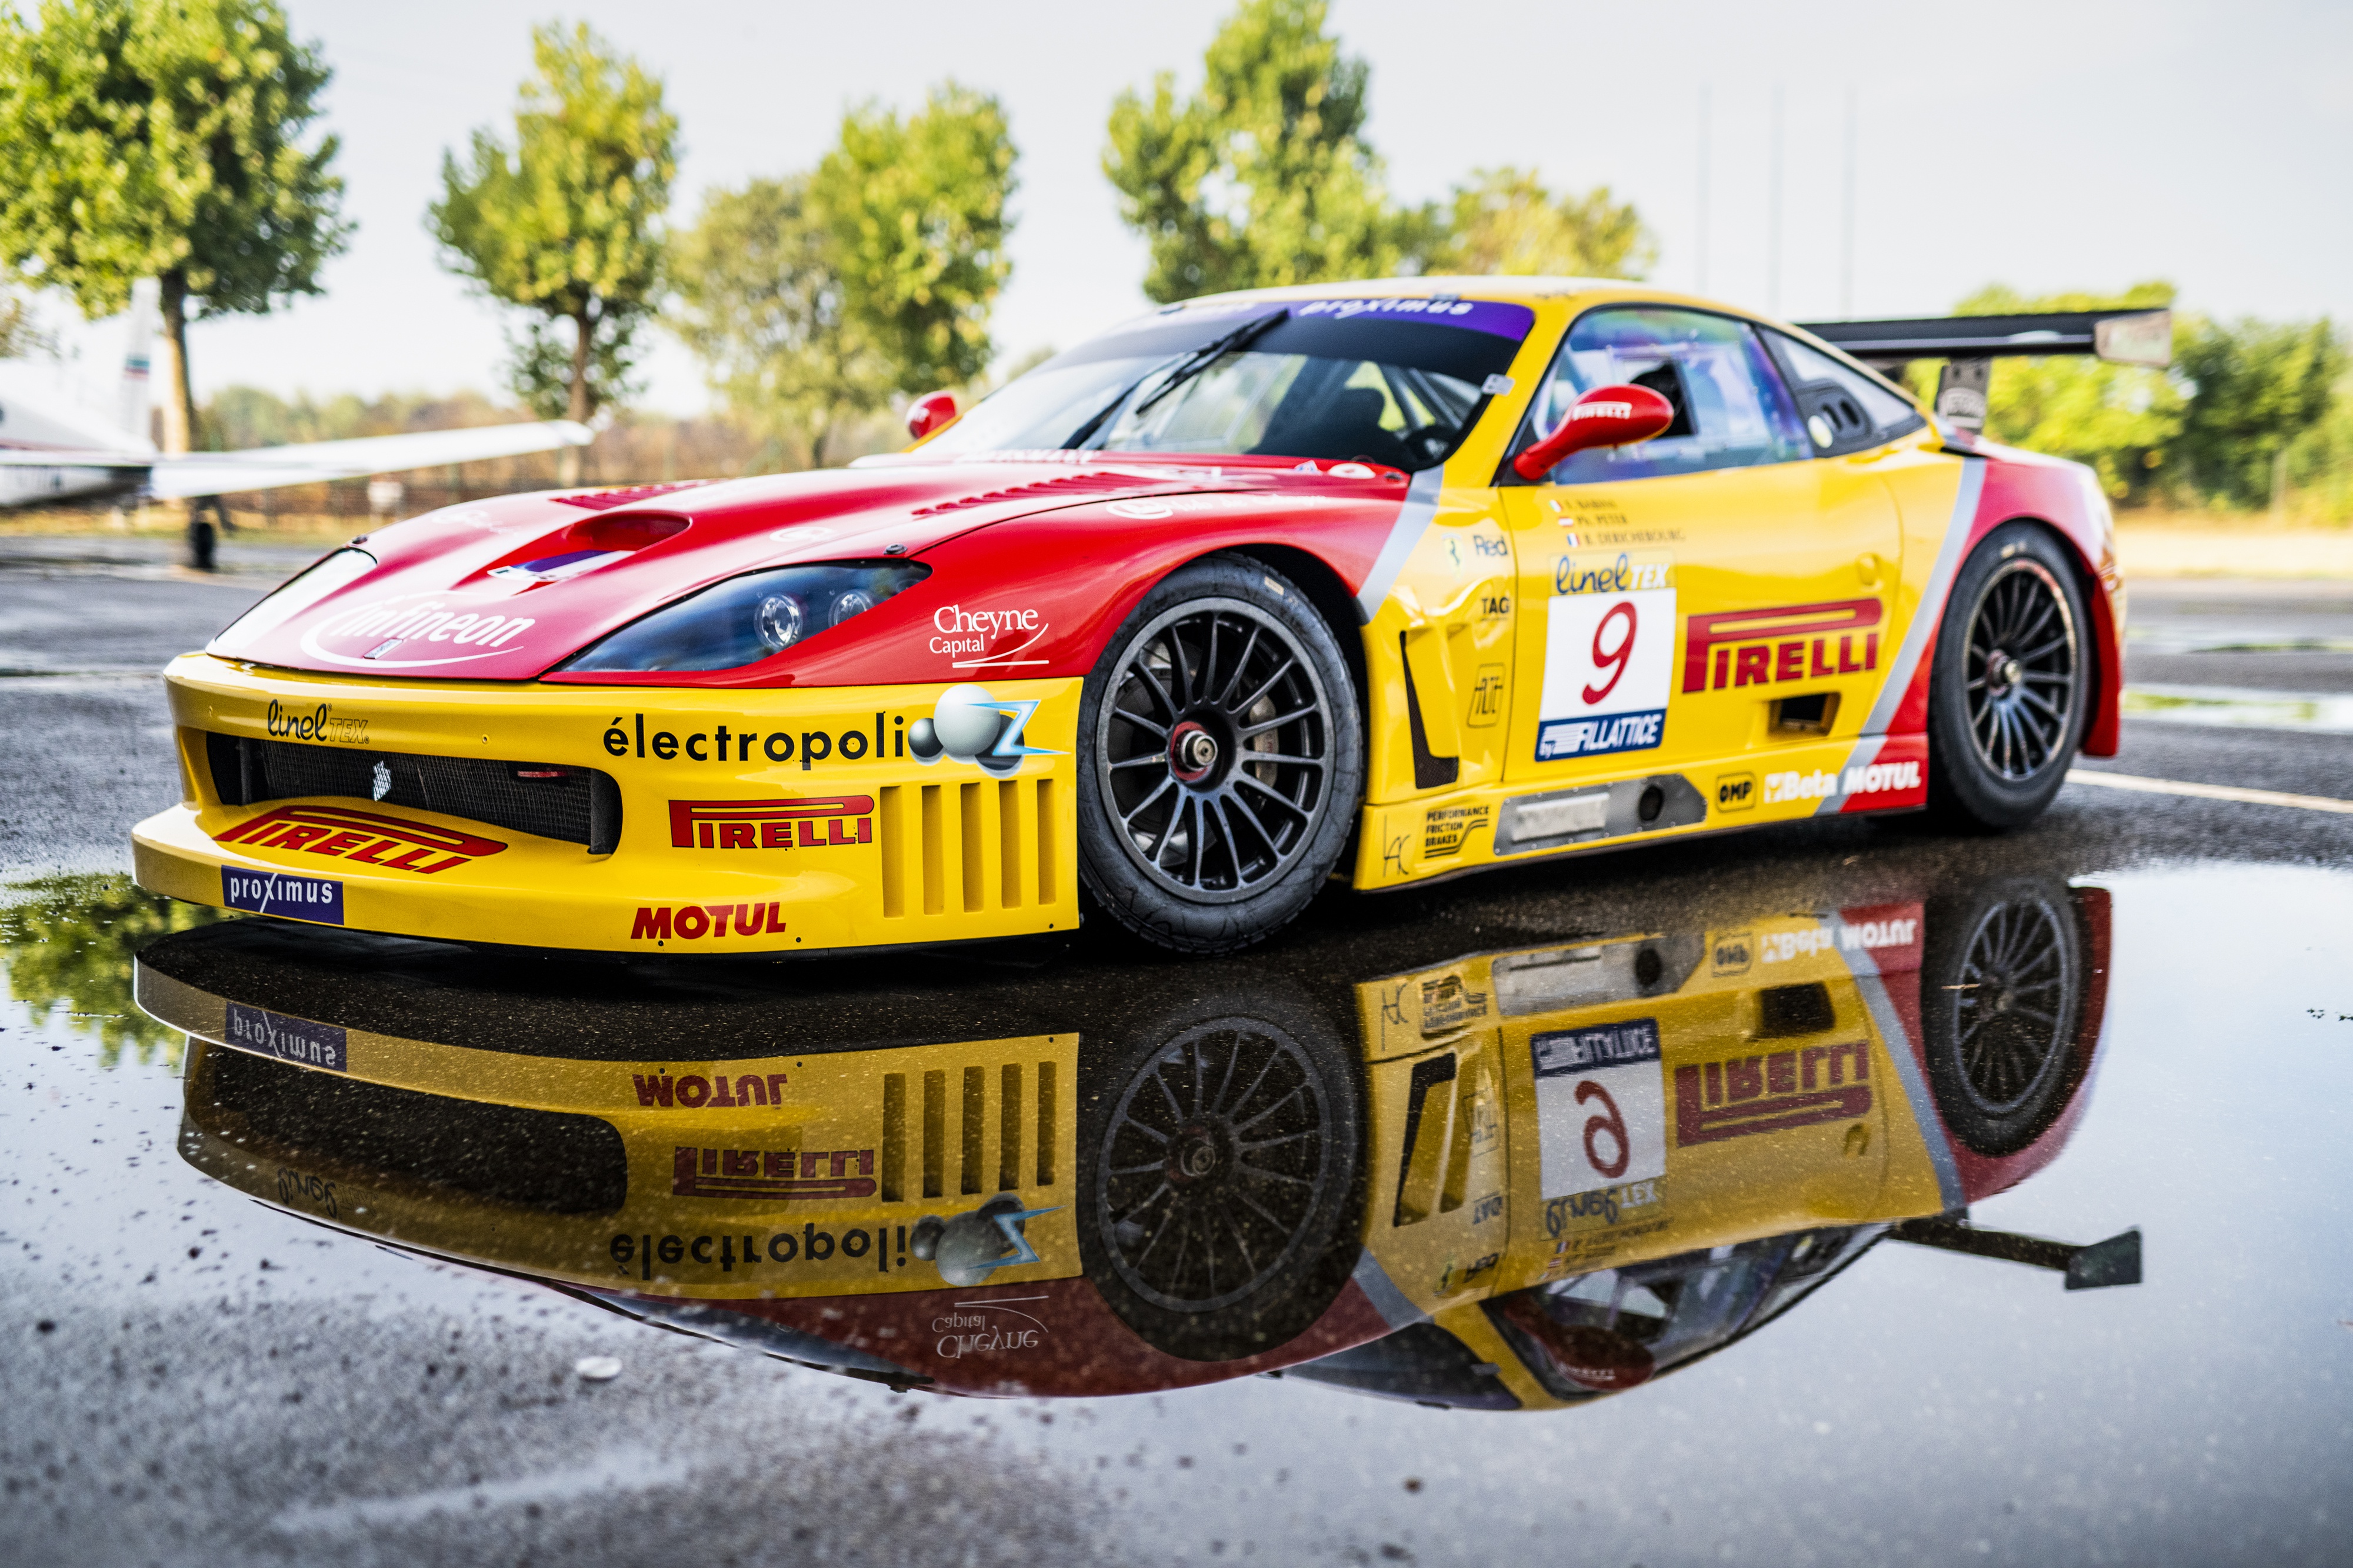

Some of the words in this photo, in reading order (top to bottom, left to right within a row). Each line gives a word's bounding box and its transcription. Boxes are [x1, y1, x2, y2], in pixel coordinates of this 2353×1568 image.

[1572, 402, 1632, 421] PIRELLI
[1474, 535, 1508, 556] Red
[1556, 552, 1629, 595] linel
[1629, 563, 1669, 589] TEX
[934, 605, 1039, 640] Cheyne
[1481, 597, 1509, 613] TAG
[929, 633, 985, 658] Capital
[1582, 601, 1638, 705] 9
[1682, 598, 1882, 694] PIRELLI
[268, 699, 328, 741] linel
[603, 712, 904, 770] électropoli
[1719, 781, 1752, 803] OMP
[1782, 769, 1838, 800] Beta
[1842, 761, 1922, 795] MOTUL
[213, 806, 508, 874] PIRELLI
[668, 795, 875, 849] PIRELLI
[230, 873, 334, 913] proximus
[631, 902, 786, 939] MOTUL
